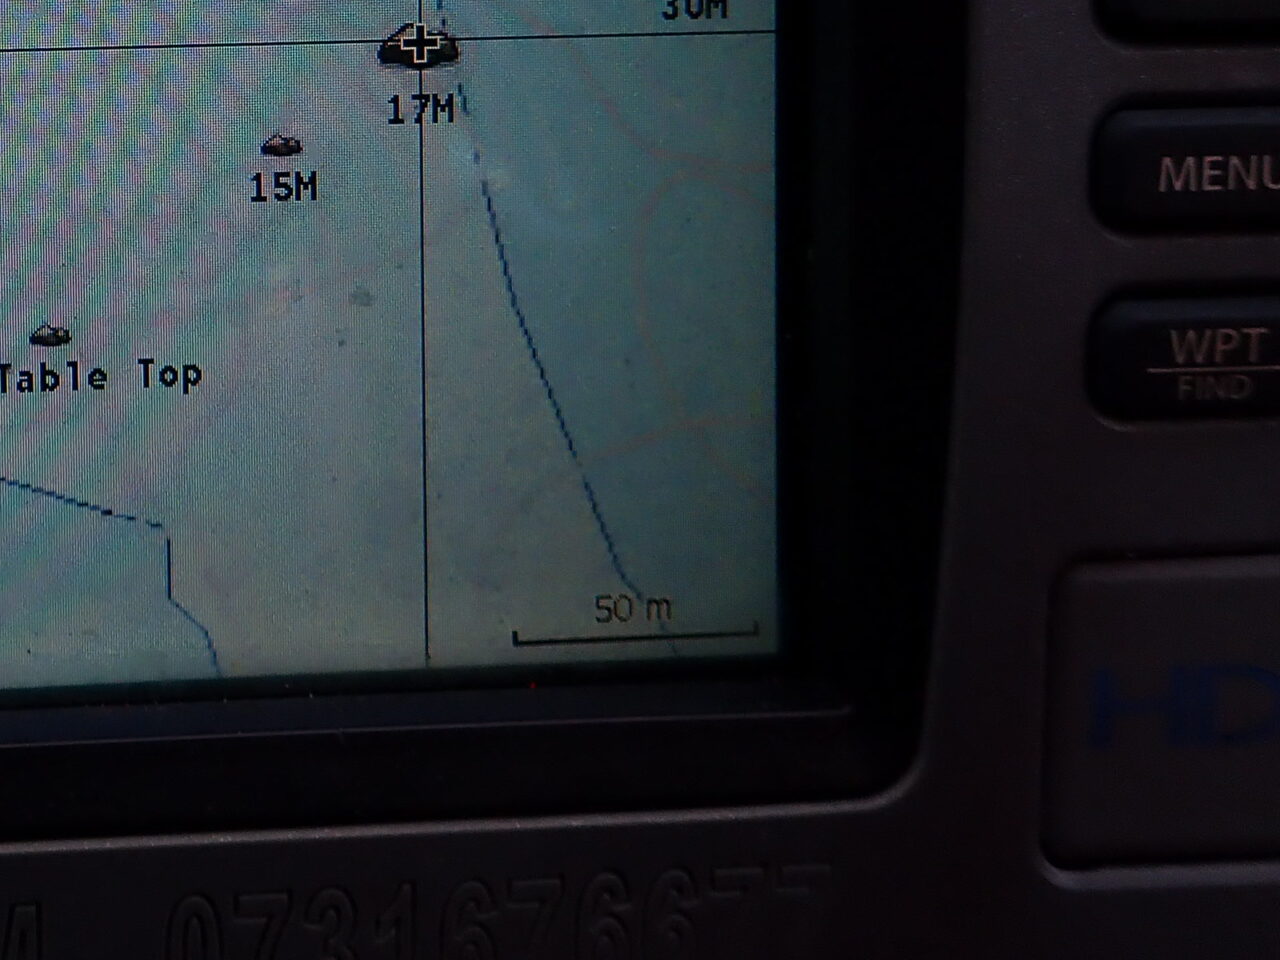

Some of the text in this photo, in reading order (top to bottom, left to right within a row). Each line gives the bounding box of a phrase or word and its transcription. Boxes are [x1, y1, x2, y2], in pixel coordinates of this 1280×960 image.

[388, 93, 454, 124] 17M
[251, 170, 317, 202] 15M
[1170, 327, 1271, 364] WPT
[137, 357, 203, 394] Top
[1177, 375, 1257, 401] FIND
[595, 593, 672, 624] 50 m
